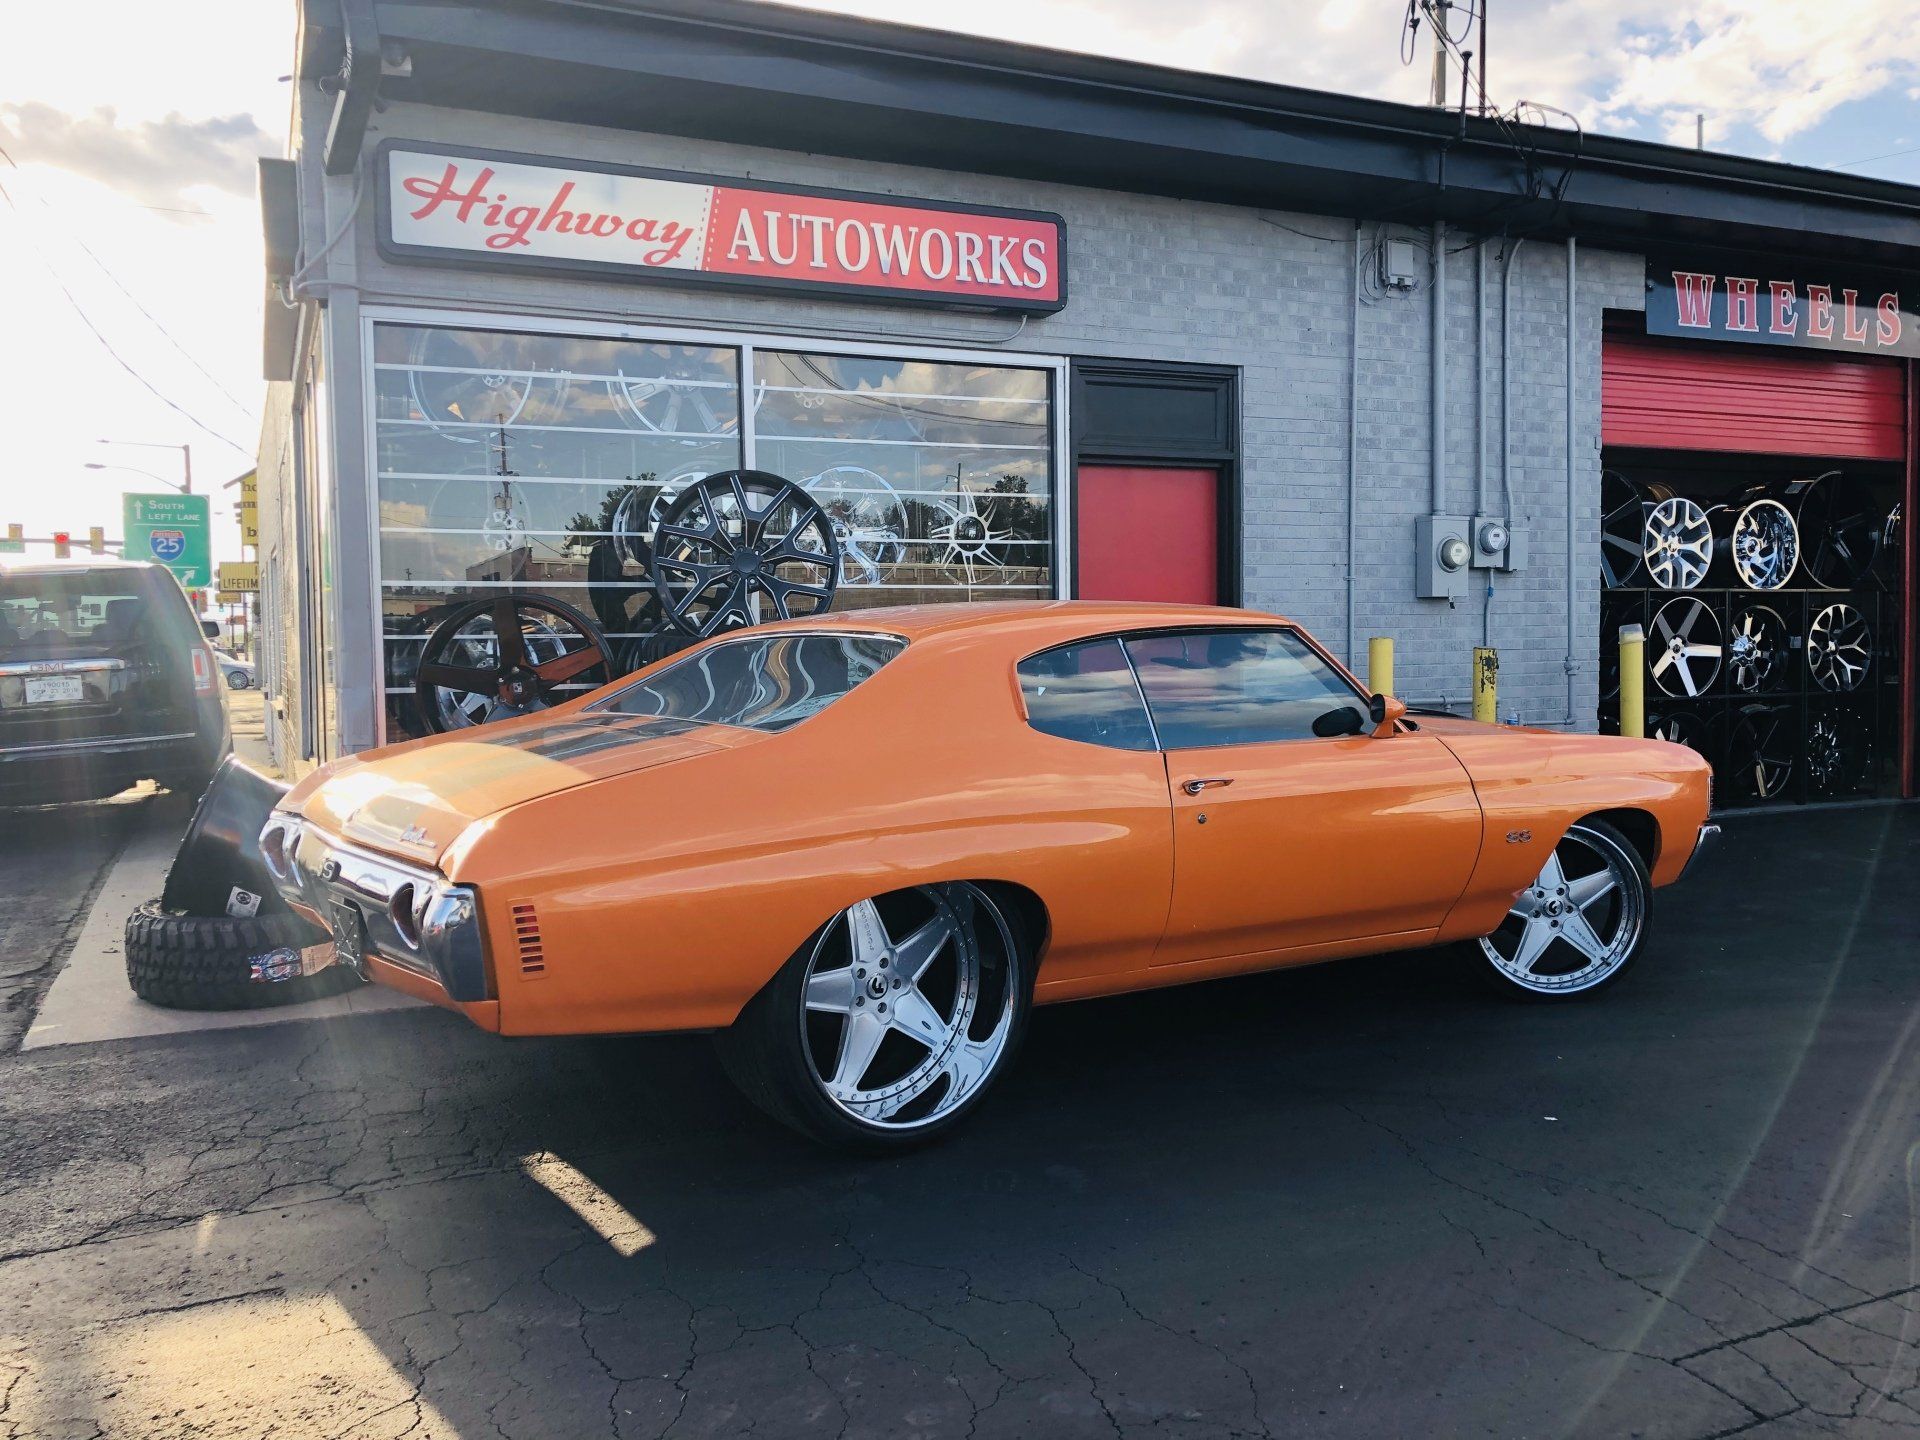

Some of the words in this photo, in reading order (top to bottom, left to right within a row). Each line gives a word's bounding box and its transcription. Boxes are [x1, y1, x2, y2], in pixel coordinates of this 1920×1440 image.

[403, 162, 694, 266] Highway
[727, 207, 1048, 289] AUTOWORKS
[1672, 271, 1902, 347] WHEELS
[148, 500, 185, 510] SOUTH
[148, 513, 171, 521] LEFT
[156, 538, 180, 553] 25
